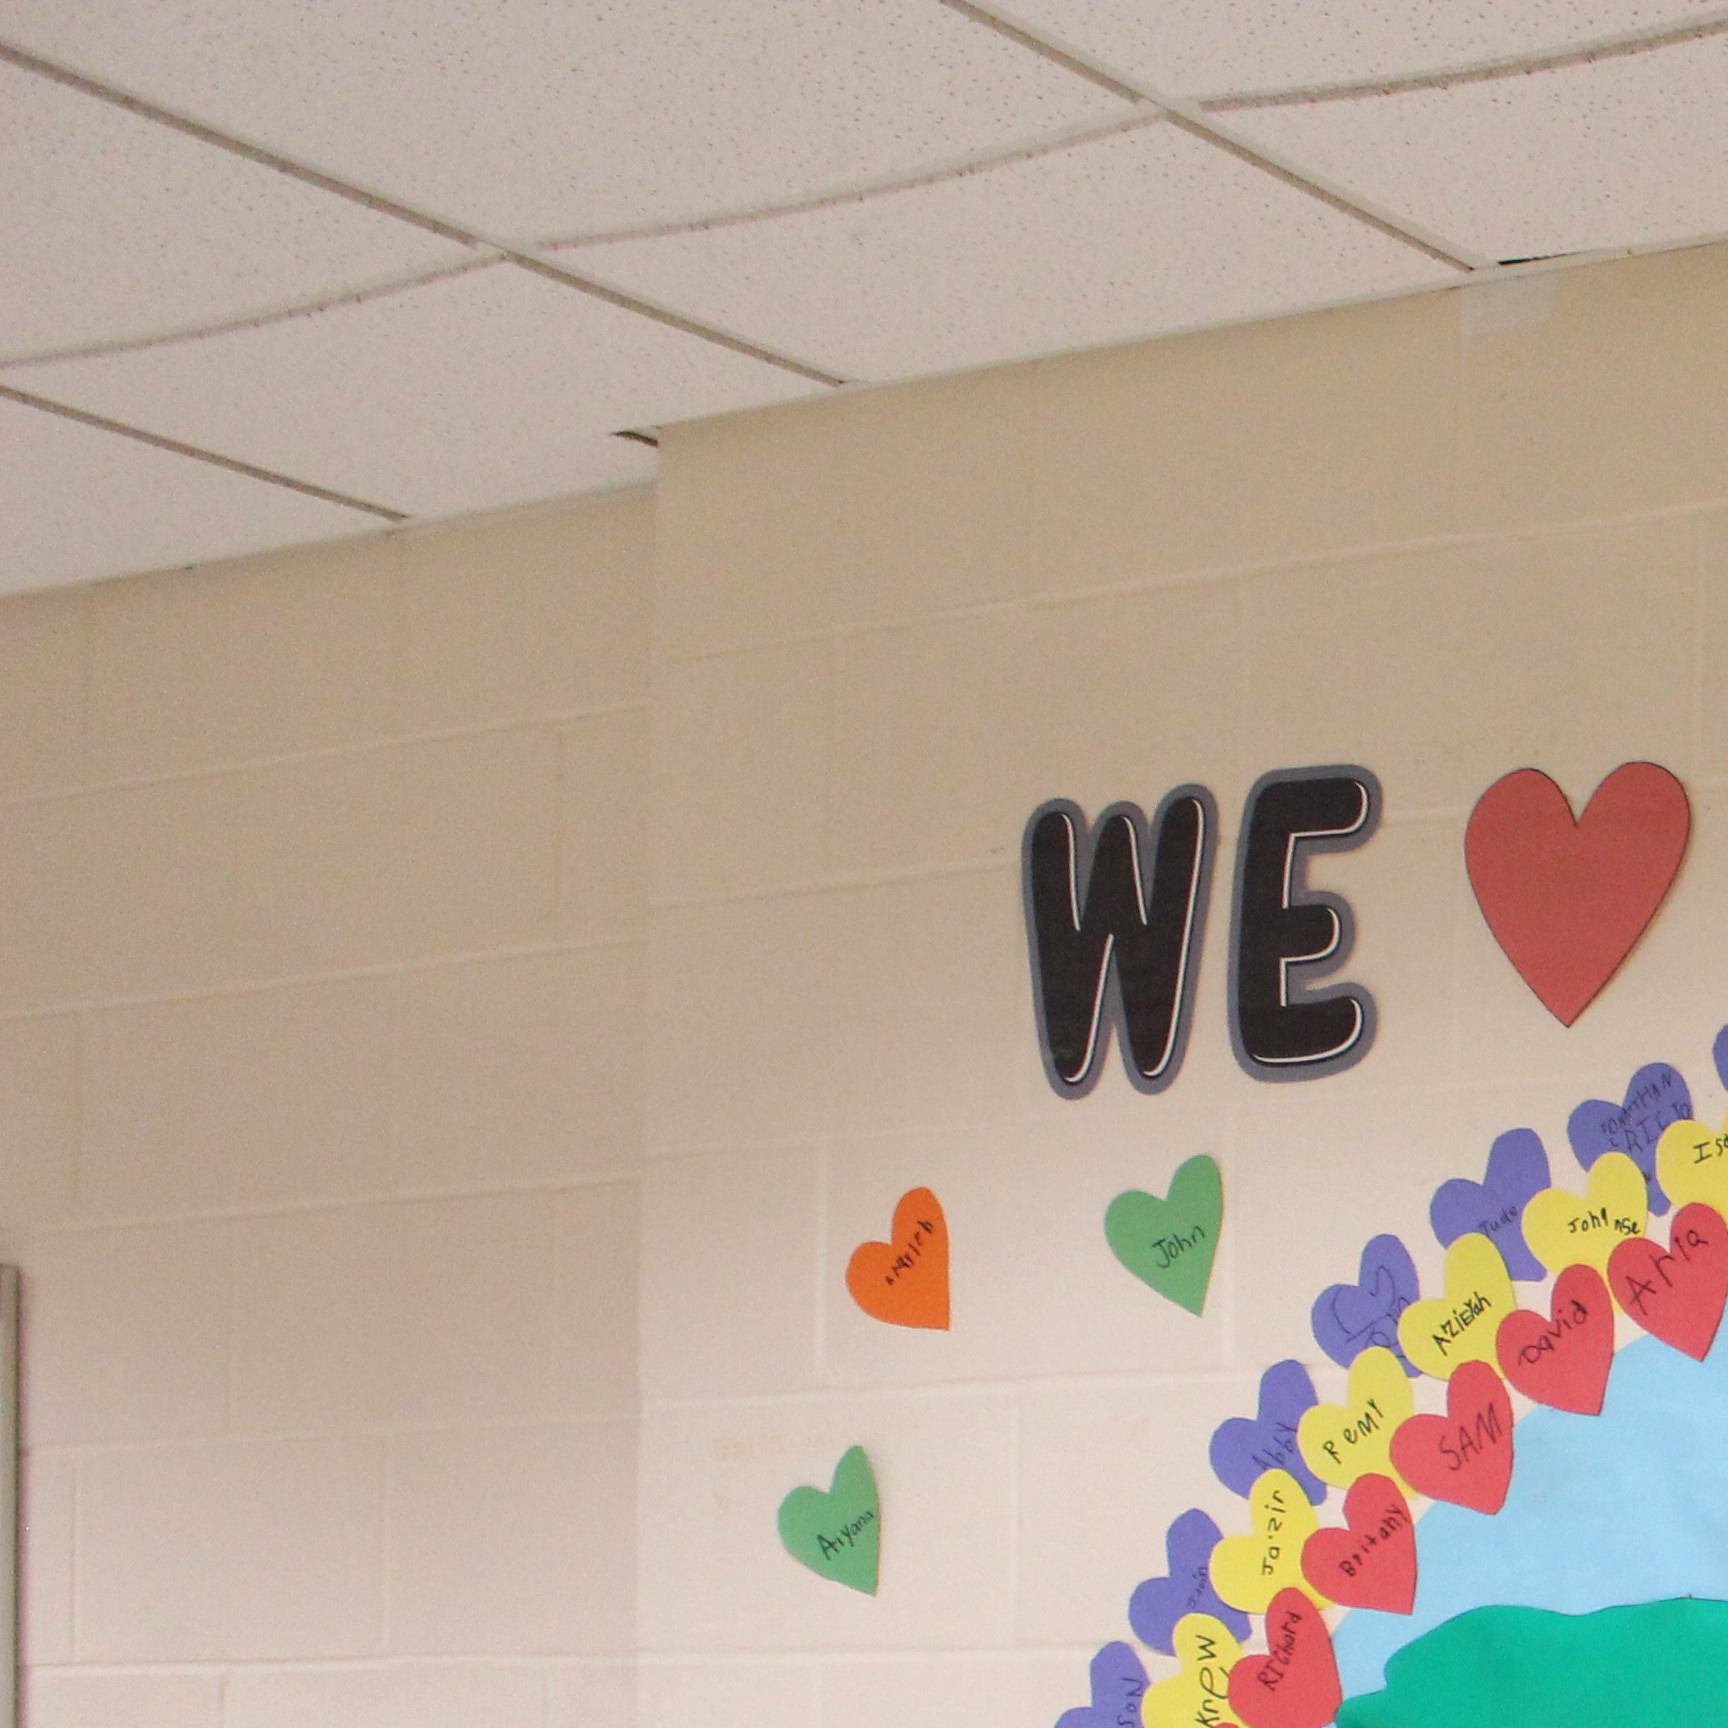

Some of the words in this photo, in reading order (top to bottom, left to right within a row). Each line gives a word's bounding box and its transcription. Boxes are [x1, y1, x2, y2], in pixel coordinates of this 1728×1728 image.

[1021, 763, 1383, 1100] WE
[1151, 1224, 1206, 1270] John
[1516, 1299, 1589, 1367] David
[1439, 1403, 1502, 1472] SAM
